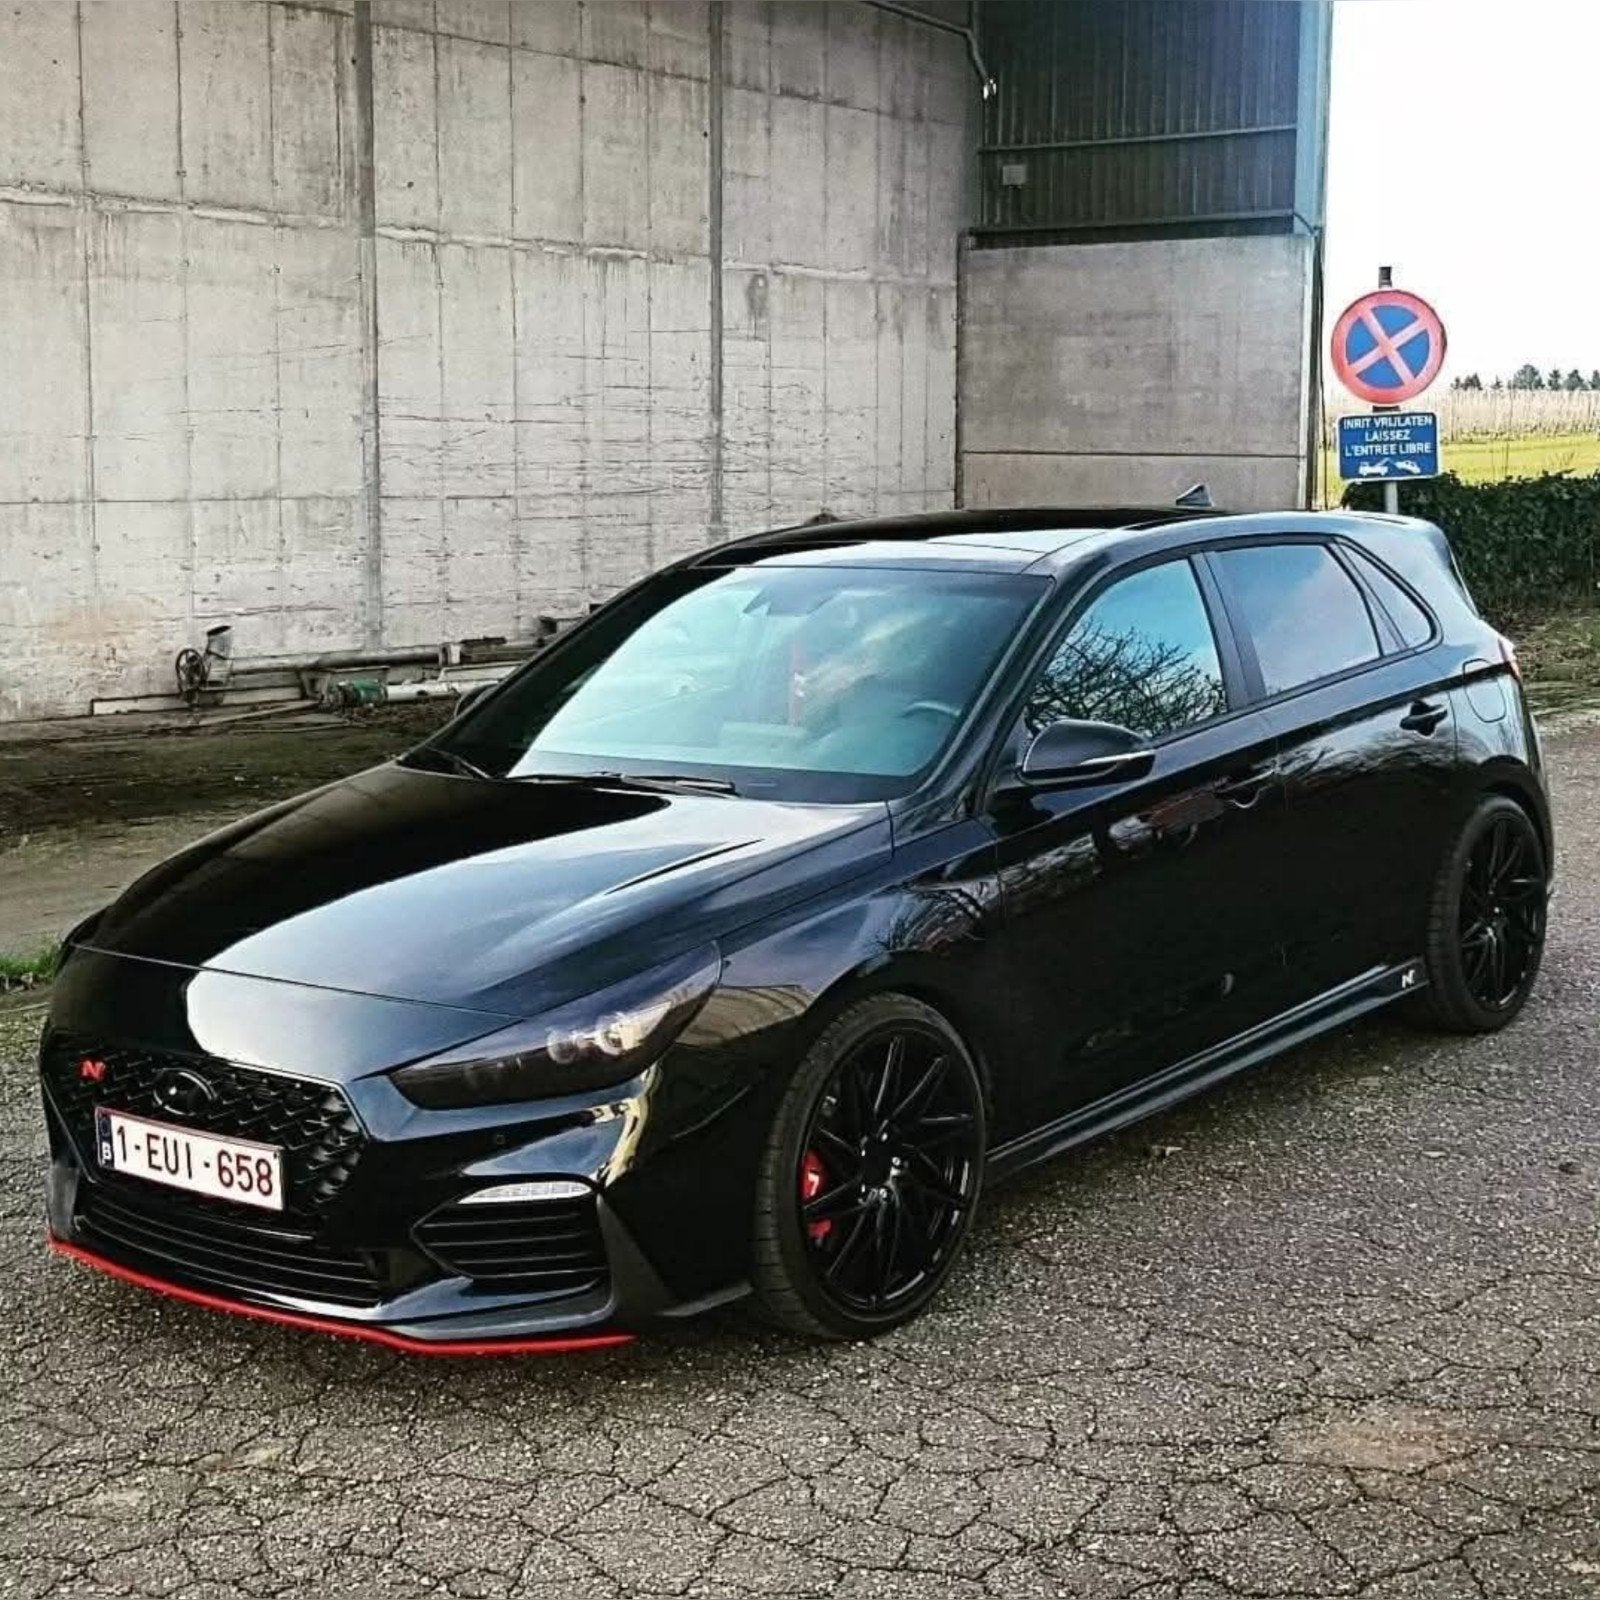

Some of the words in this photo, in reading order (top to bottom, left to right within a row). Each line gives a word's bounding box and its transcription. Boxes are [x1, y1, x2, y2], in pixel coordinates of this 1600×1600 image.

[1343, 418, 1371, 430] INRIT
[1373, 416, 1433, 428] VRIJLATEN
[1364, 429, 1411, 442] LAISSEZ
[1399, 442, 1432, 454] LIBRE
